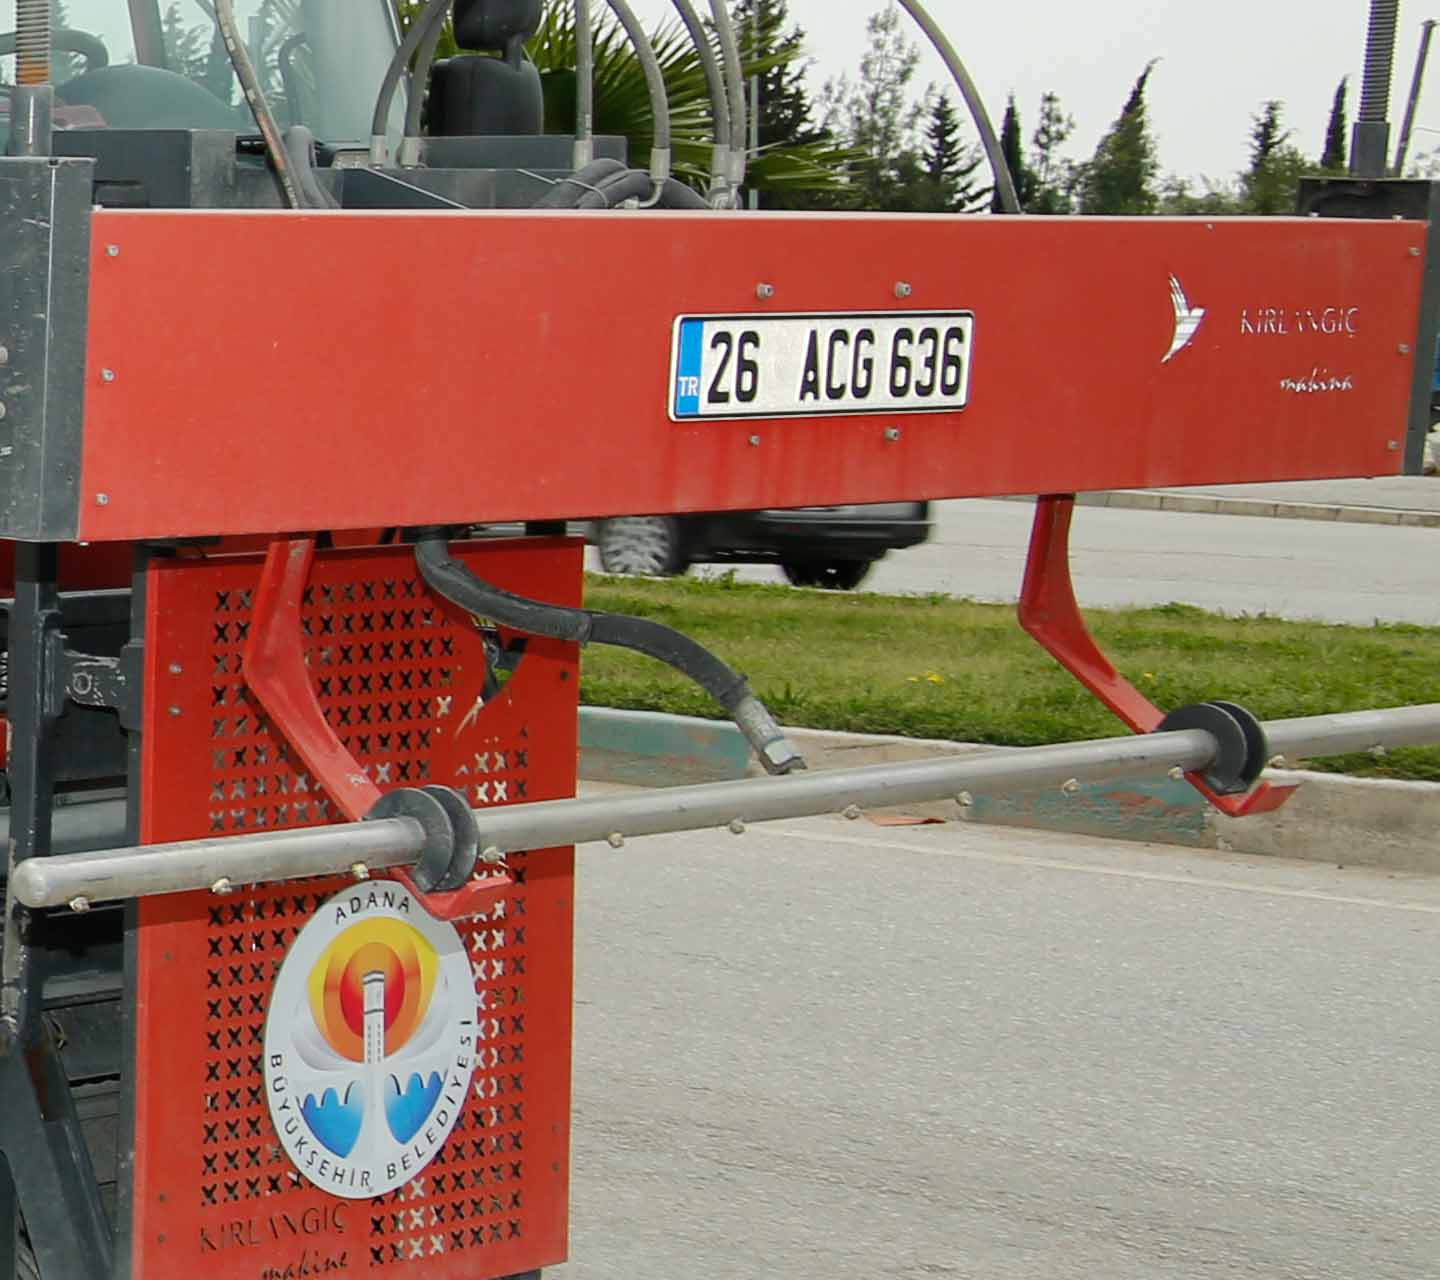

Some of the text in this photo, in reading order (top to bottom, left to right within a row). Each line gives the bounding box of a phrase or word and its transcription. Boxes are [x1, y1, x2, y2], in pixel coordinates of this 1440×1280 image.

[678, 325, 965, 404] TR 26 ACG 636
[335, 891, 411, 925] ADANA
[270, 1053, 374, 1189] BÜYÜKŞEHİR
